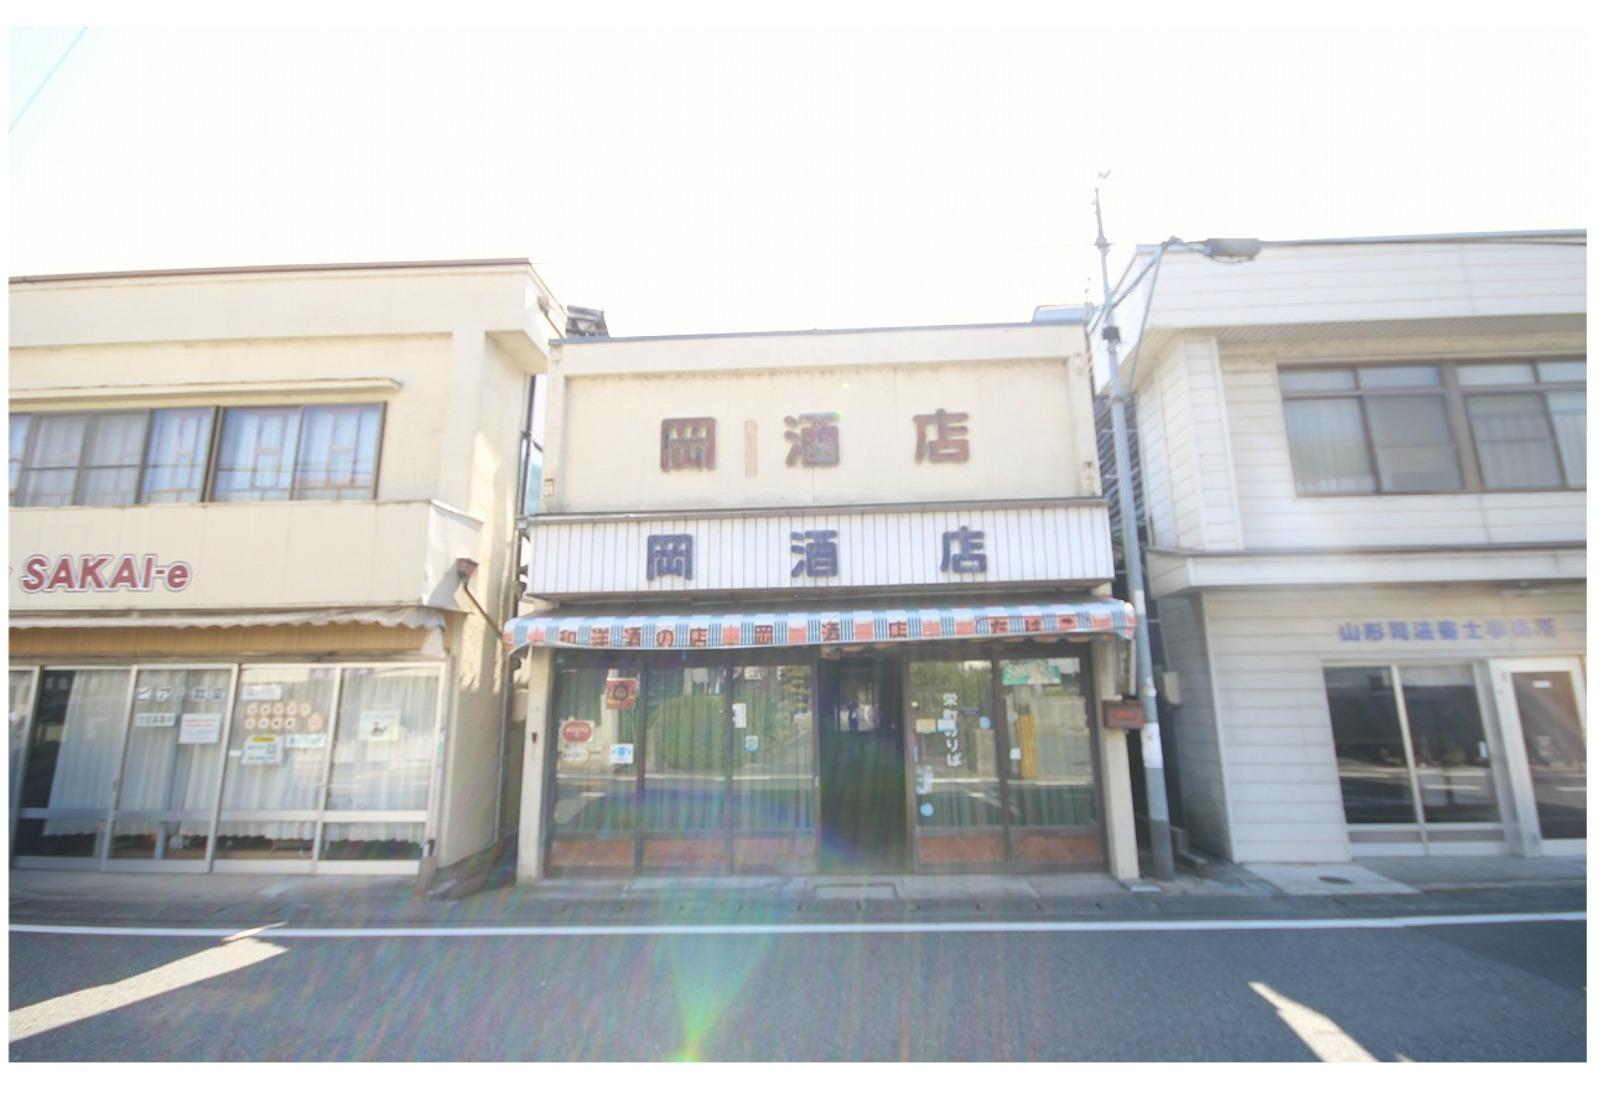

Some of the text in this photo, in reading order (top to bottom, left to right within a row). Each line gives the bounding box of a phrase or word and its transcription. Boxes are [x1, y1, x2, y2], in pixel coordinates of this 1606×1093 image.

[660, 408, 970, 473] 岡酒店
[21, 554, 192, 593] SAKAI-e
[646, 525, 987, 581] 岡酒店
